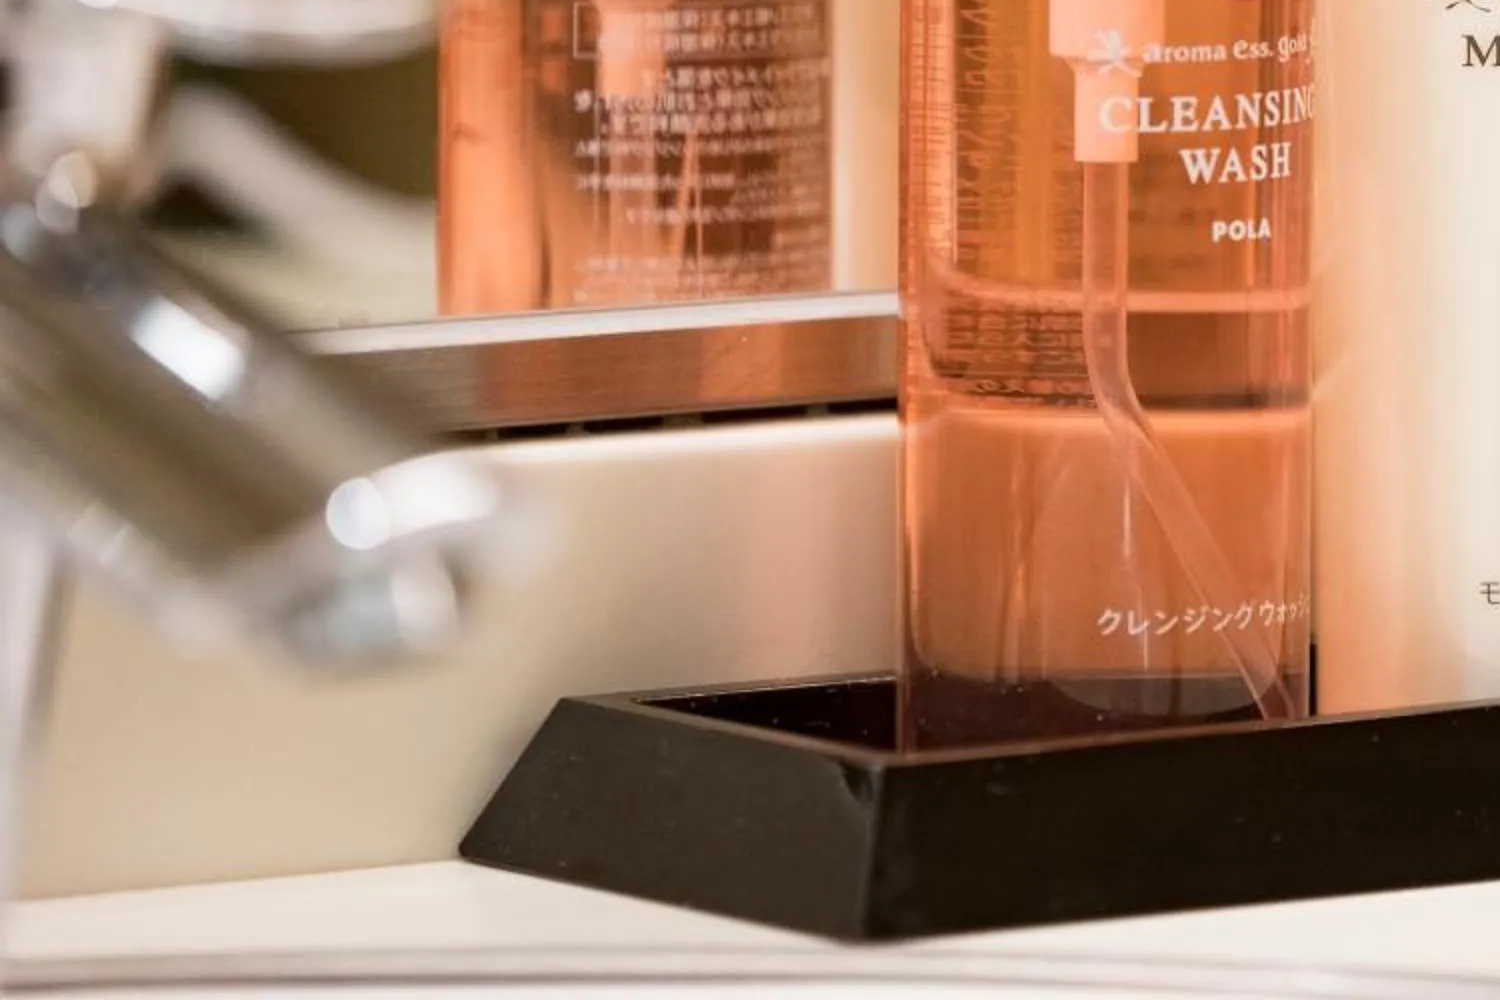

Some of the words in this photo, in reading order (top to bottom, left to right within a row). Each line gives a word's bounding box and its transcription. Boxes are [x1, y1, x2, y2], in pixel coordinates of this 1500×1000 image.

[1141, 40, 1227, 64] aroma
[1178, 141, 1293, 186] WASH
[1210, 217, 1272, 244] POLA
